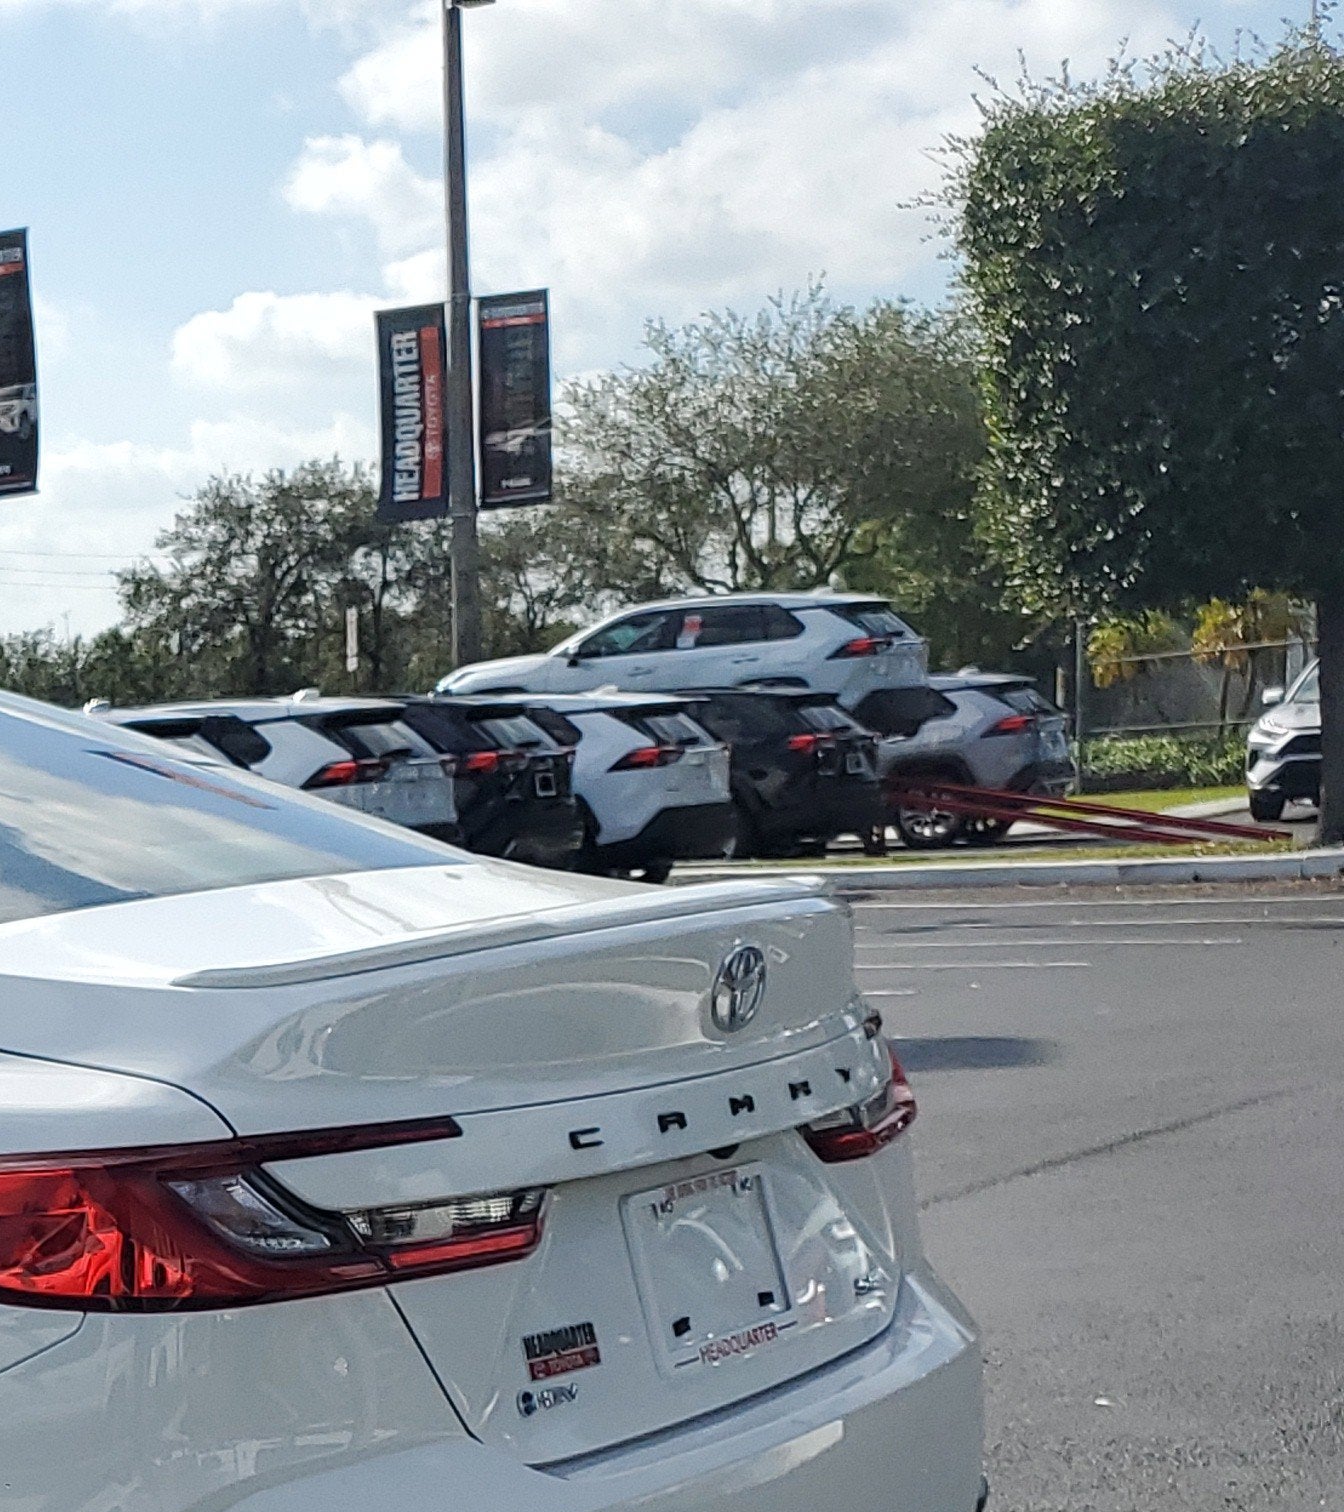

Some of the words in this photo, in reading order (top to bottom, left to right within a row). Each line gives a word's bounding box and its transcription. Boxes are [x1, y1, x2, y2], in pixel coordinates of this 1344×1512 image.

[391, 331, 421, 502] HEADQUARTER
[568, 1066, 853, 1151] CAMRY
[522, 1321, 597, 1360] HEADQUARTER
[699, 1321, 778, 1364] HEADQUARTER
